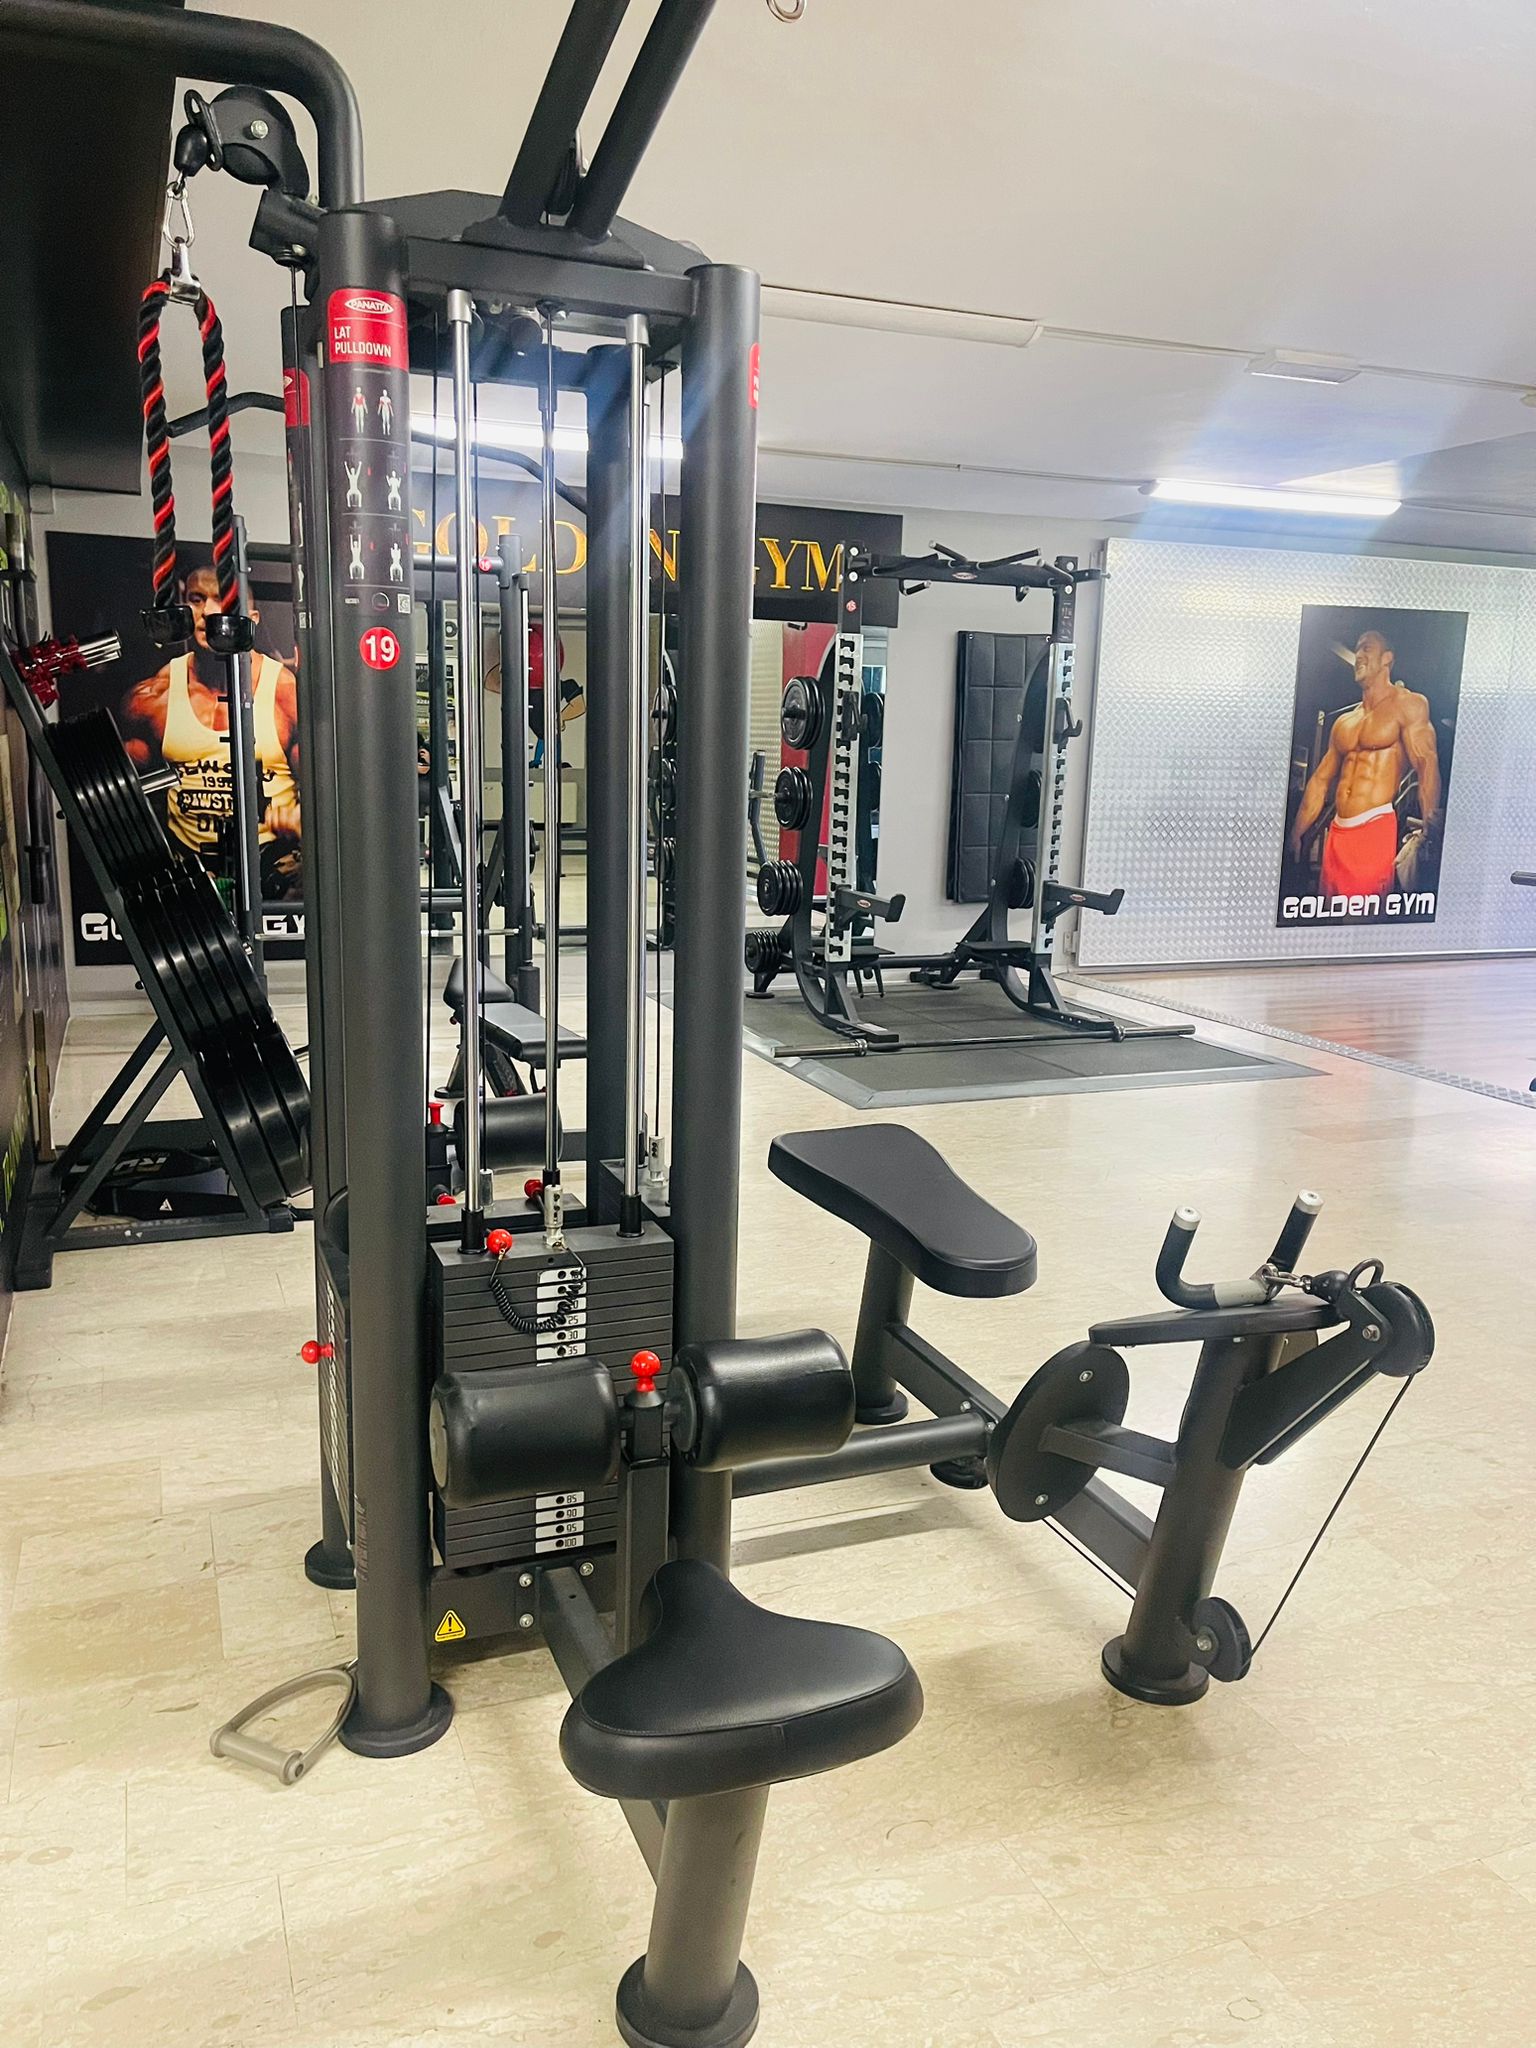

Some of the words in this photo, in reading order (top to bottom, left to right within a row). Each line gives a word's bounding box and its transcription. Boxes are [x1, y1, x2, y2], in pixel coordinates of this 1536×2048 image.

[350, 300, 391, 313] PANATTA
[333, 326, 351, 339] LAT
[335, 341, 392, 358] PULLDOWN
[365, 634, 396, 663] 19
[568, 1315, 579, 1325] 25
[568, 1330, 579, 1340] 30
[567, 1345, 578, 1355] 35
[566, 1508, 577, 1518] 90
[564, 1537, 577, 1548] 100
